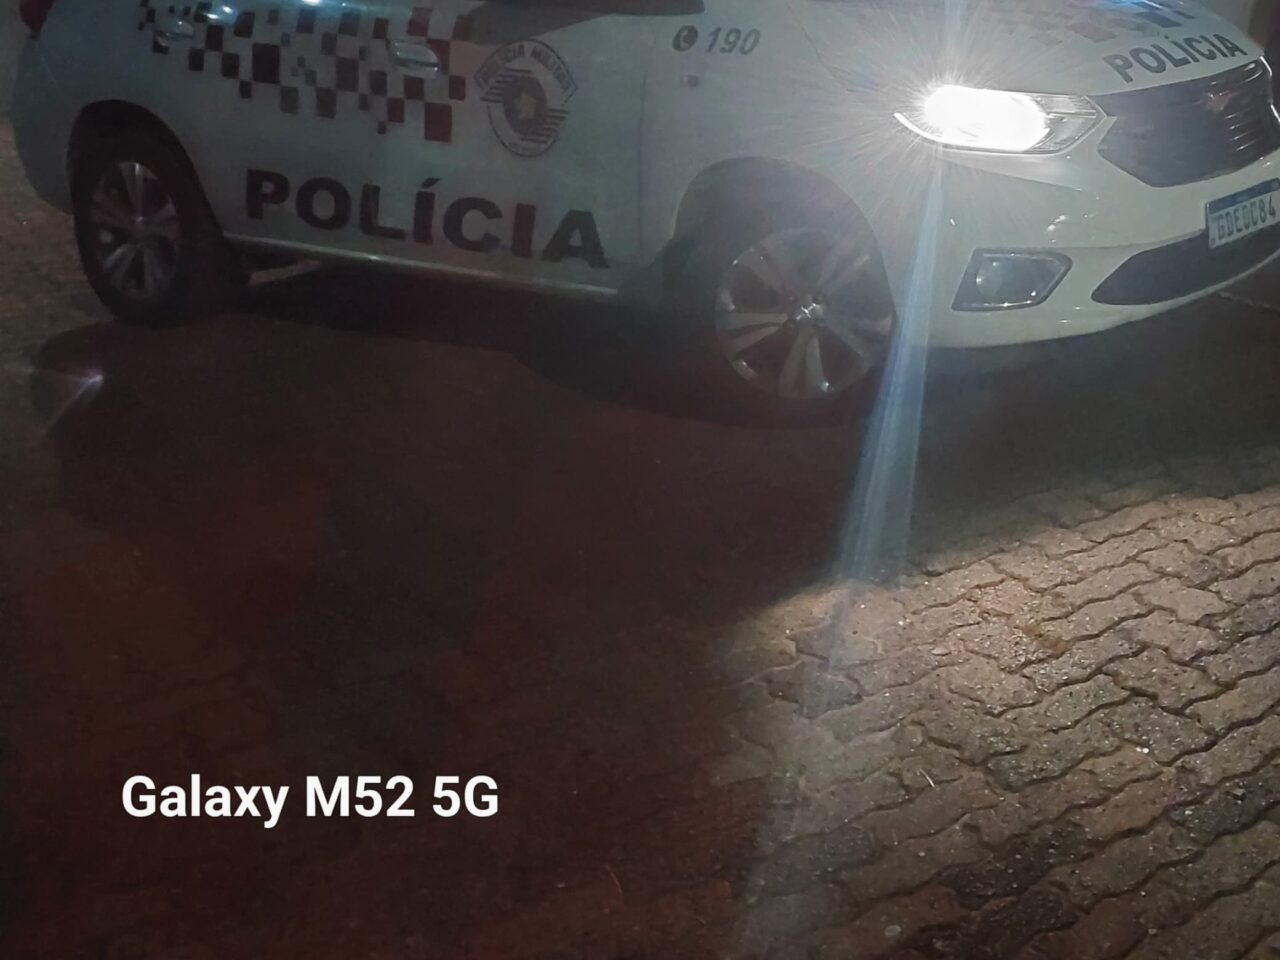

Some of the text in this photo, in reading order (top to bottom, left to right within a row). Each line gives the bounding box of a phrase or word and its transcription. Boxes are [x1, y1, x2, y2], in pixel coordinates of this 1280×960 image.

[707, 27, 761, 55] 190
[1102, 33, 1248, 84] POLÍCIA
[245, 168, 609, 269] POLÍCIA
